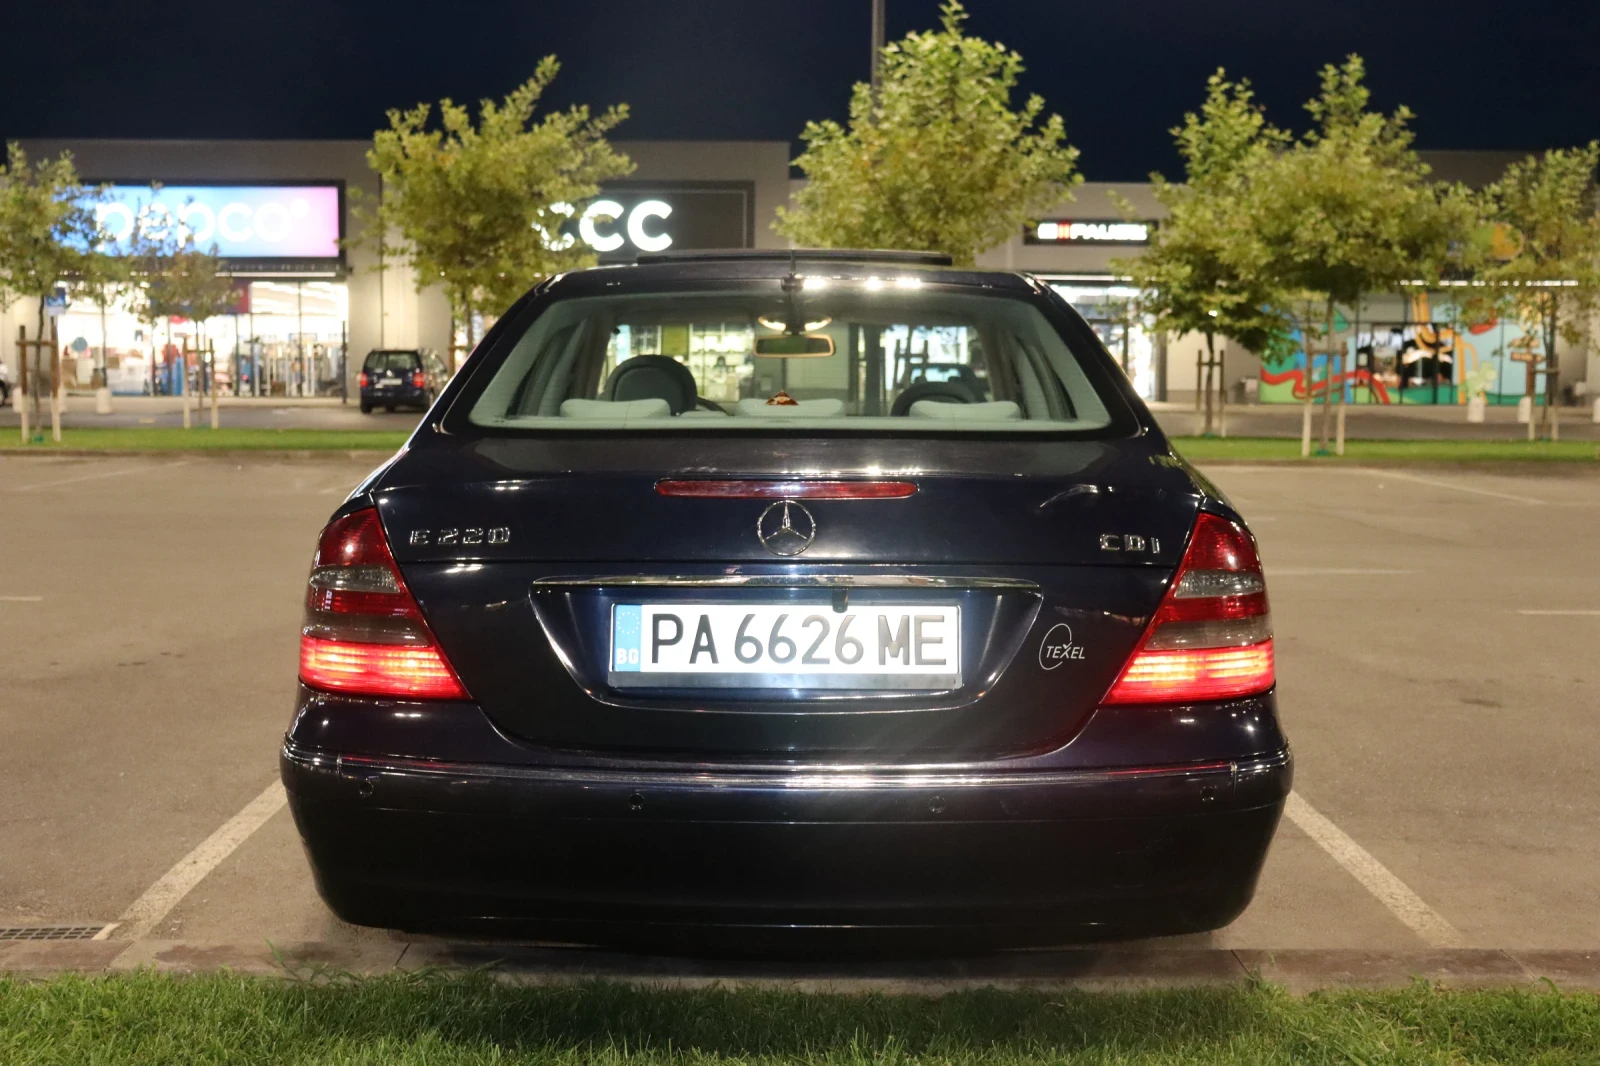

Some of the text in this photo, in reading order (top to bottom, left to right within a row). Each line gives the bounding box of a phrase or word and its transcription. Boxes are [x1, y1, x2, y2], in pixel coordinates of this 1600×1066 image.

[94, 200, 294, 252] pepco
[438, 526, 511, 545] 220
[1099, 533, 1160, 554] CDI
[733, 613, 864, 665] 6626
[616, 647, 640, 665] BG
[1046, 641, 1086, 660] TEXEL
